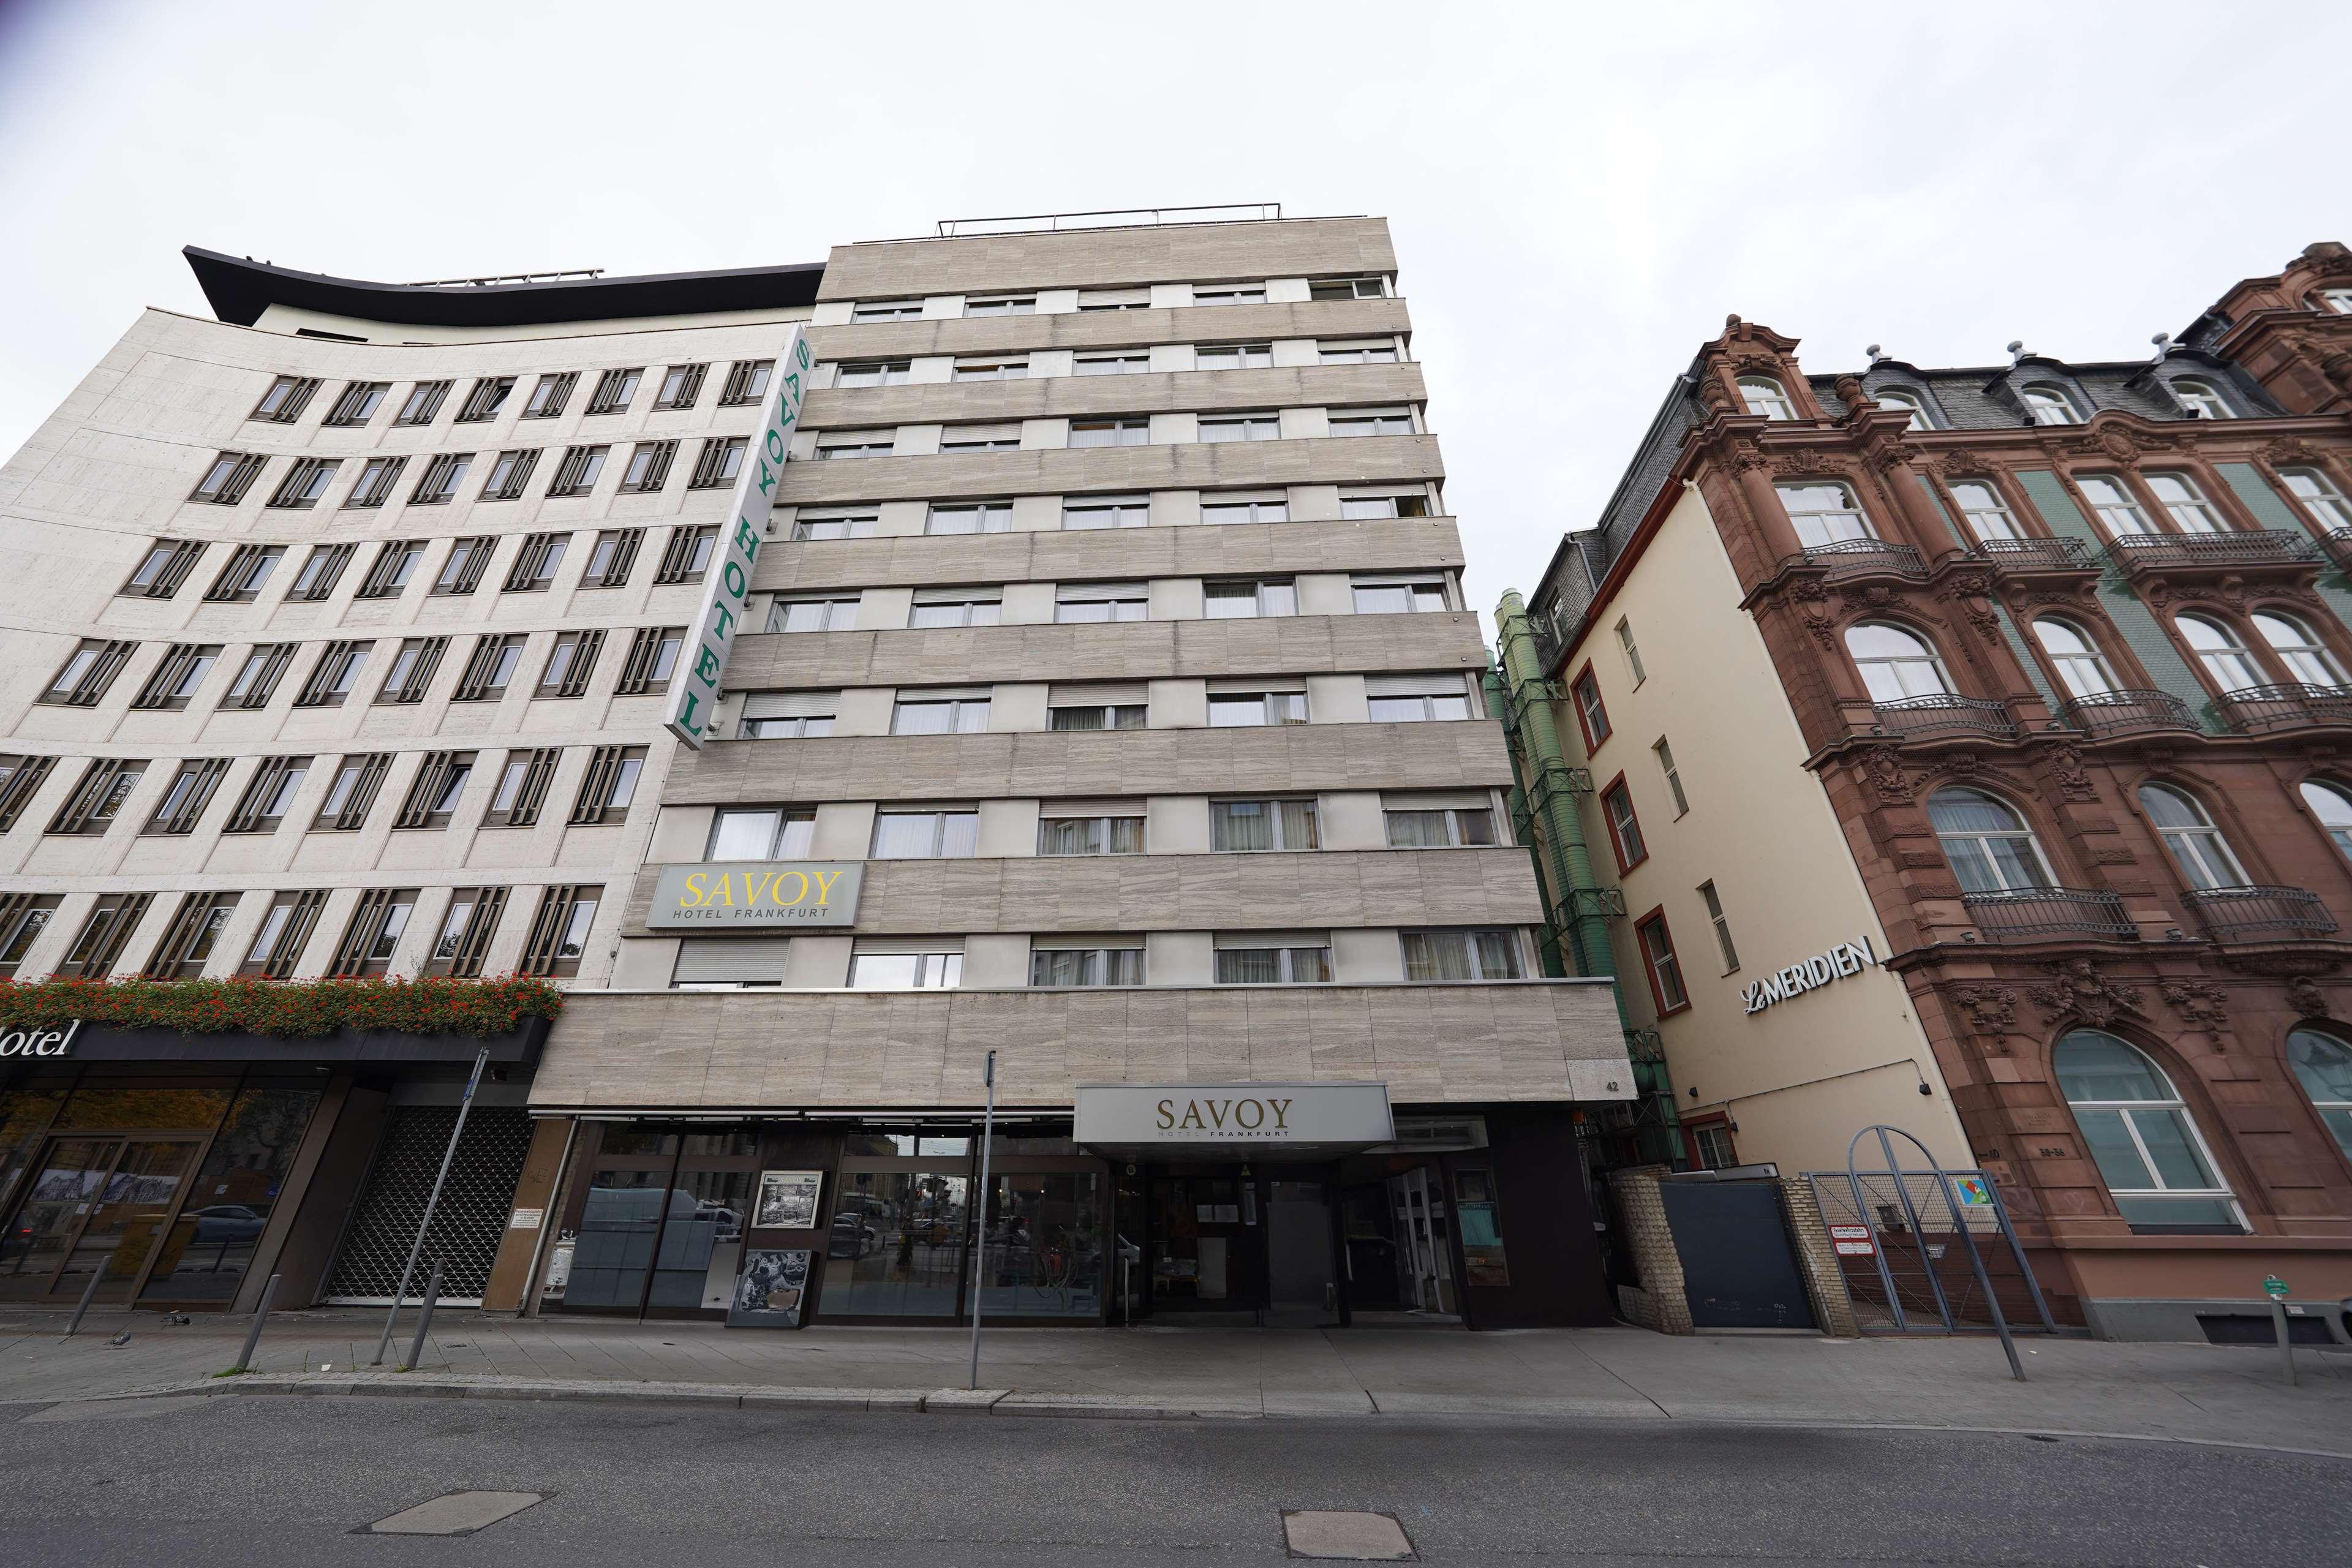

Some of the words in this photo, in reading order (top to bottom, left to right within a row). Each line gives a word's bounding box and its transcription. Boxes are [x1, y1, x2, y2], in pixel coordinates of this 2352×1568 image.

[759, 339, 809, 497] SAVOY
[679, 515, 760, 736] HOTEL
[680, 872, 843, 907] SAVOY
[673, 910, 722, 919] HOTEL
[734, 908, 828, 918] FRANKFURT
[1740, 981, 1766, 1014] Le
[1763, 935, 1877, 1005] MERIDIEN
[0, 1019, 81, 1056] otel
[1607, 1081, 1619, 1091] 42
[1157, 1099, 1292, 1129] SAVOY
